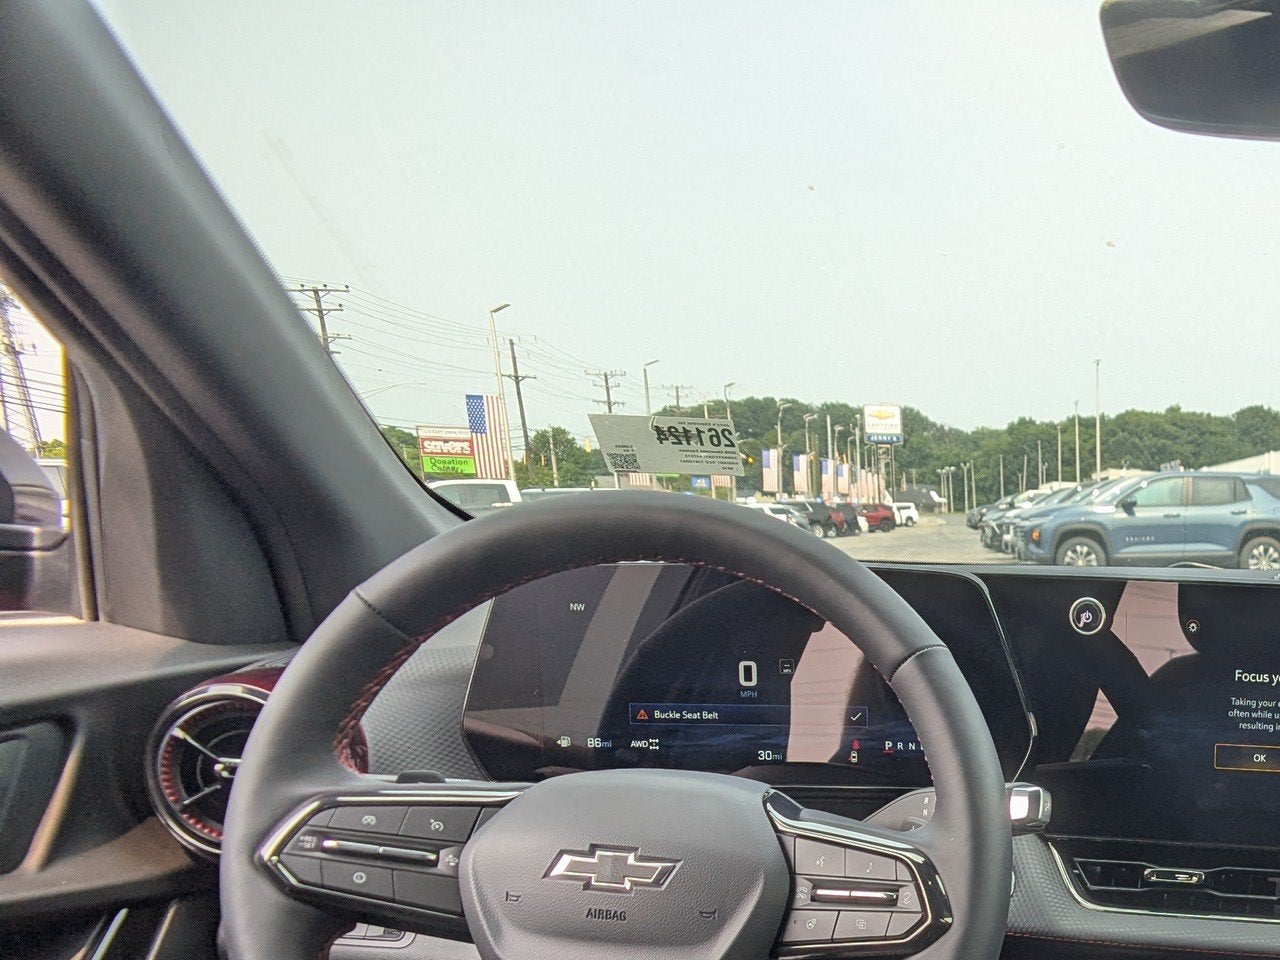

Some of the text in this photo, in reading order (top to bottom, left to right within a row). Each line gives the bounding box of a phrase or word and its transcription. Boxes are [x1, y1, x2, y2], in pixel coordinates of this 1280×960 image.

[430, 458, 468, 466] Donation
[569, 602, 586, 611] NW
[738, 661, 758, 687] 0
[1235, 670, 1269, 682] Focus
[740, 690, 758, 698] MPH
[1231, 697, 1256, 708] Taking
[1258, 700, 1275, 709] your
[654, 710, 719, 720] Buckle Seat Belt
[1228, 709, 1250, 718] often
[1251, 710, 1272, 719] while
[1239, 722, 1273, 732] resulting
[630, 740, 649, 748] AWD
[885, 741, 892, 750] P
[897, 742, 904, 750] R
[909, 742, 916, 750] N
[1253, 753, 1267, 763] OK
[585, 908, 627, 921] AIRBAG
